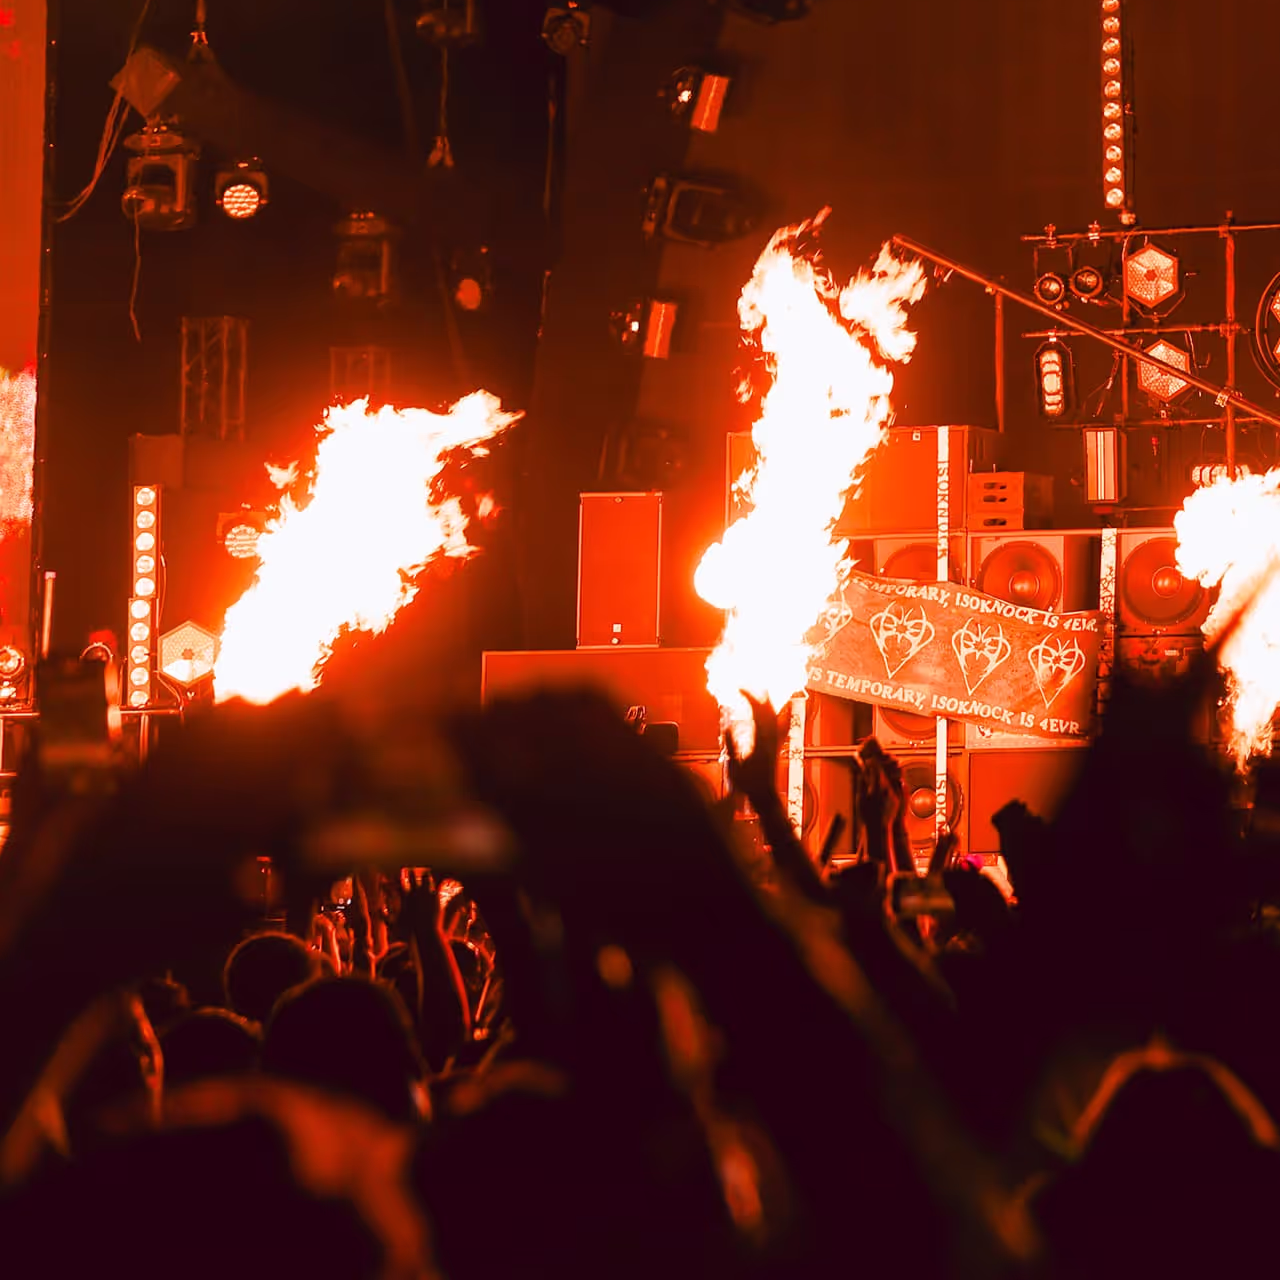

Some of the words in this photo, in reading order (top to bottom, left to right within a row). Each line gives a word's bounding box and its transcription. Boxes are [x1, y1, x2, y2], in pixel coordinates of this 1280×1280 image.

[955, 592, 1038, 625] ISOKNOCK
[826, 670, 926, 710] TEMPORARY,
[931, 694, 1014, 725] ISOKNOCK
[1020, 711, 1035, 728] IS
